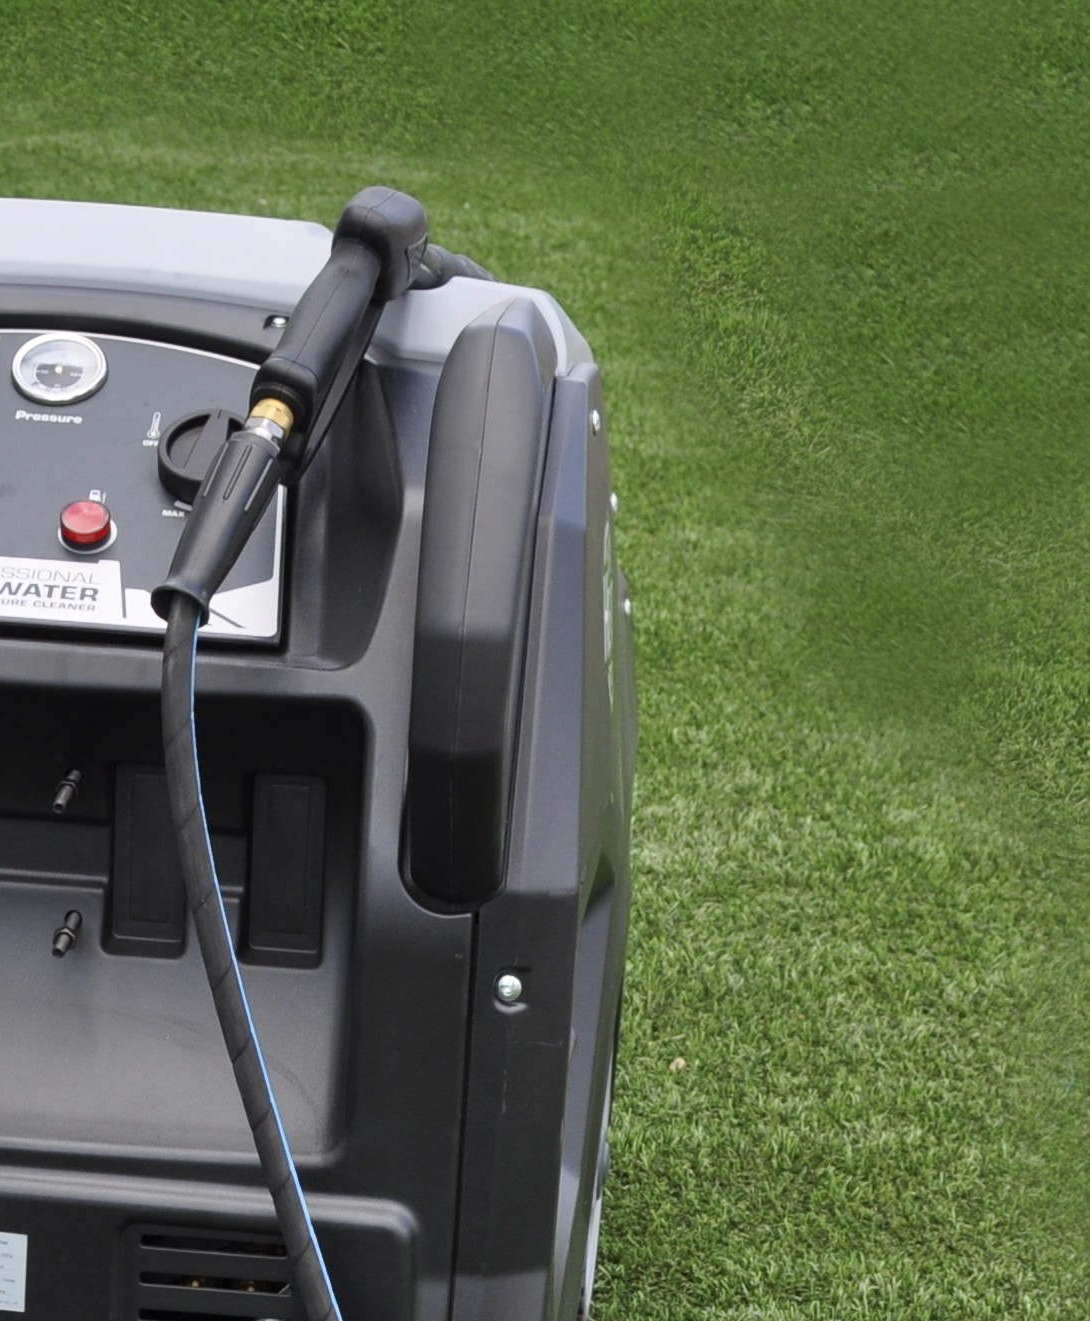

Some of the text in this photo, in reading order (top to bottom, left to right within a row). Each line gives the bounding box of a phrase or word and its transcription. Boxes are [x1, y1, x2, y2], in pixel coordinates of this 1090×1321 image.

[15, 410, 82, 424] Pressure
[161, 509, 185, 518] MAX
[33, 600, 96, 612] CLEANER
